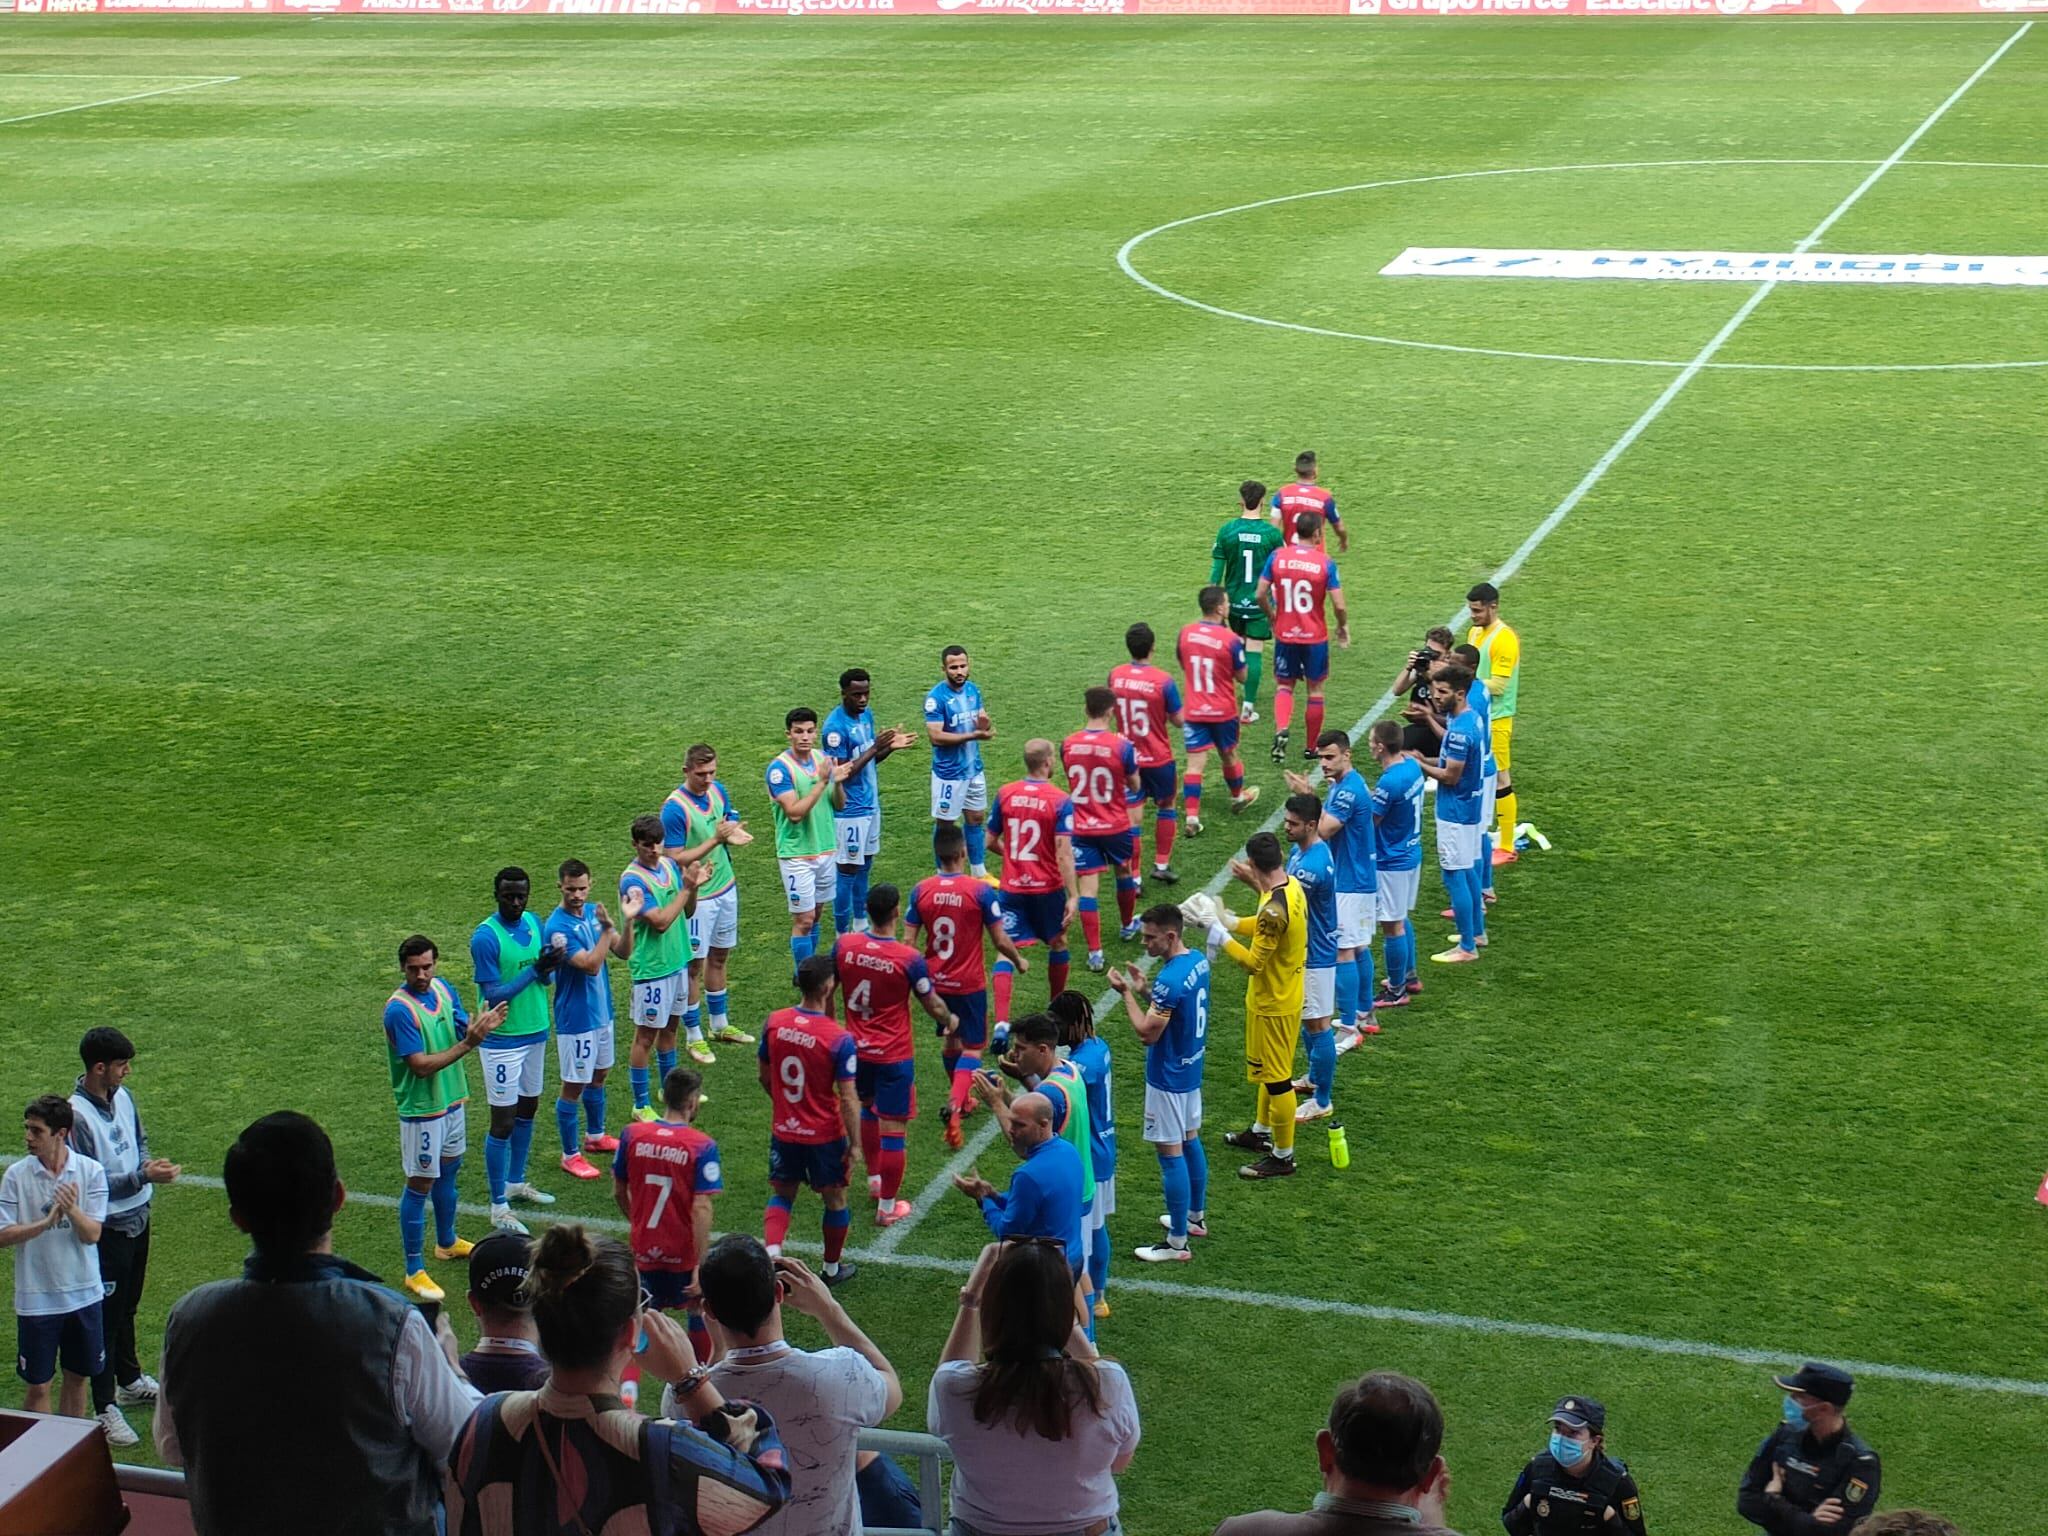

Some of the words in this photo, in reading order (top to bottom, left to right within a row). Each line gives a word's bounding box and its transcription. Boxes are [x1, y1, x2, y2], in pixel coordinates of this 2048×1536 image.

[1242, 549, 1254, 583] 1
[1280, 577, 1314, 615] 16
[1189, 655, 1216, 695] 11
[1116, 697, 1151, 737] 15
[940, 783, 954, 801] 18
[1067, 763, 1114, 805] 20
[847, 826, 860, 843] 21
[1006, 816, 1042, 862] 12
[788, 874, 797, 891] 2
[932, 915, 956, 961] 8
[643, 985, 662, 1006] 38
[847, 979, 875, 1022] 4
[1195, 986, 1208, 1039] 6
[575, 1038, 592, 1060] 15
[495, 1062, 507, 1084] 8
[780, 1055, 806, 1105] 9
[421, 1130, 431, 1152] 3
[644, 1173, 674, 1230] 7
